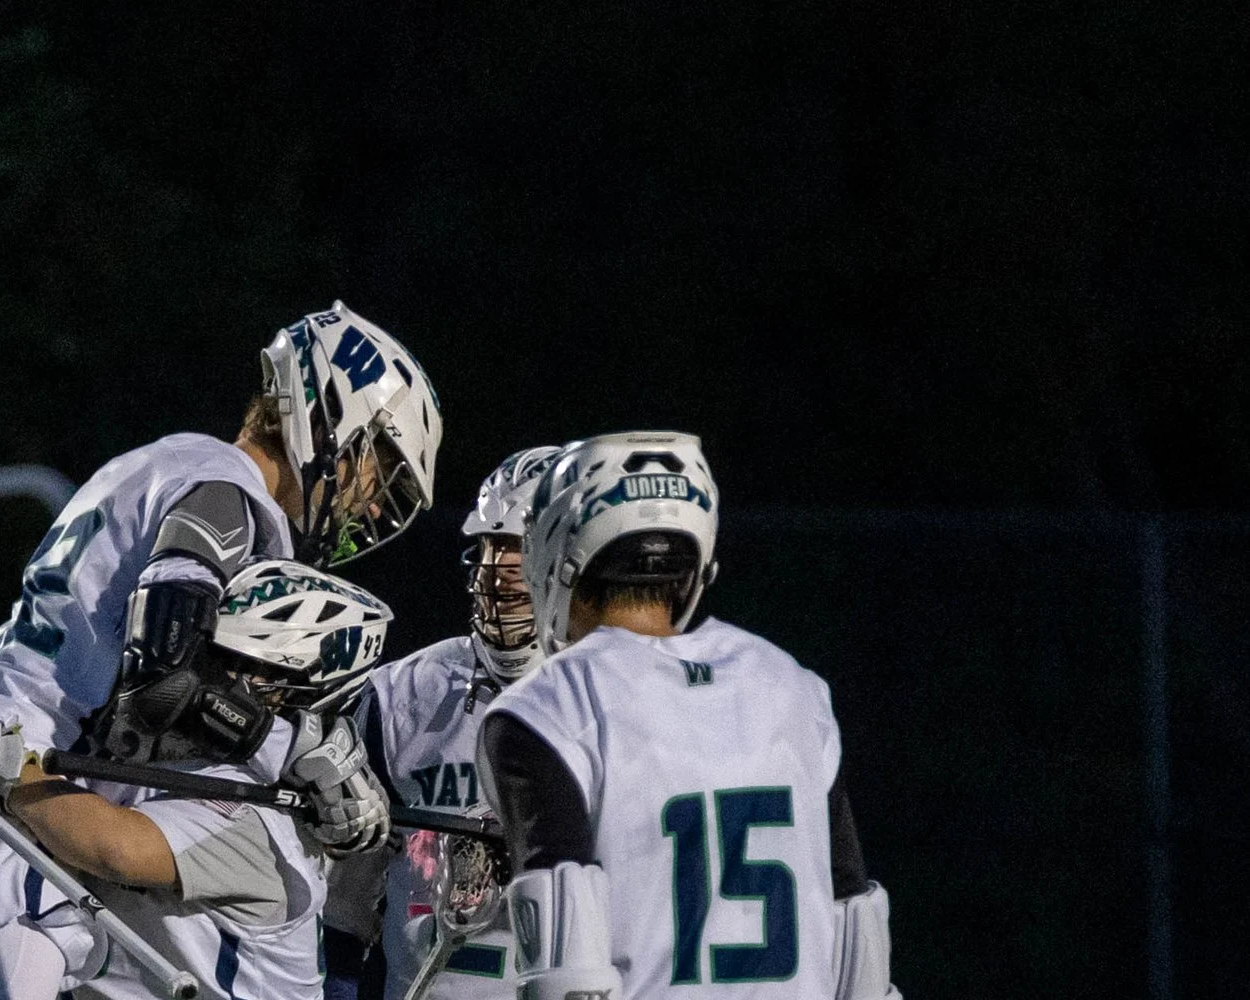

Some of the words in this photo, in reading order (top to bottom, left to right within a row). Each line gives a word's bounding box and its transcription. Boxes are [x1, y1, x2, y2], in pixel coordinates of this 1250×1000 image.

[625, 475, 688, 498] UNITED
[363, 634, 381, 660] 42
[682, 659, 714, 686] W
[211, 699, 247, 727] Integra
[661, 785, 800, 985] 15
